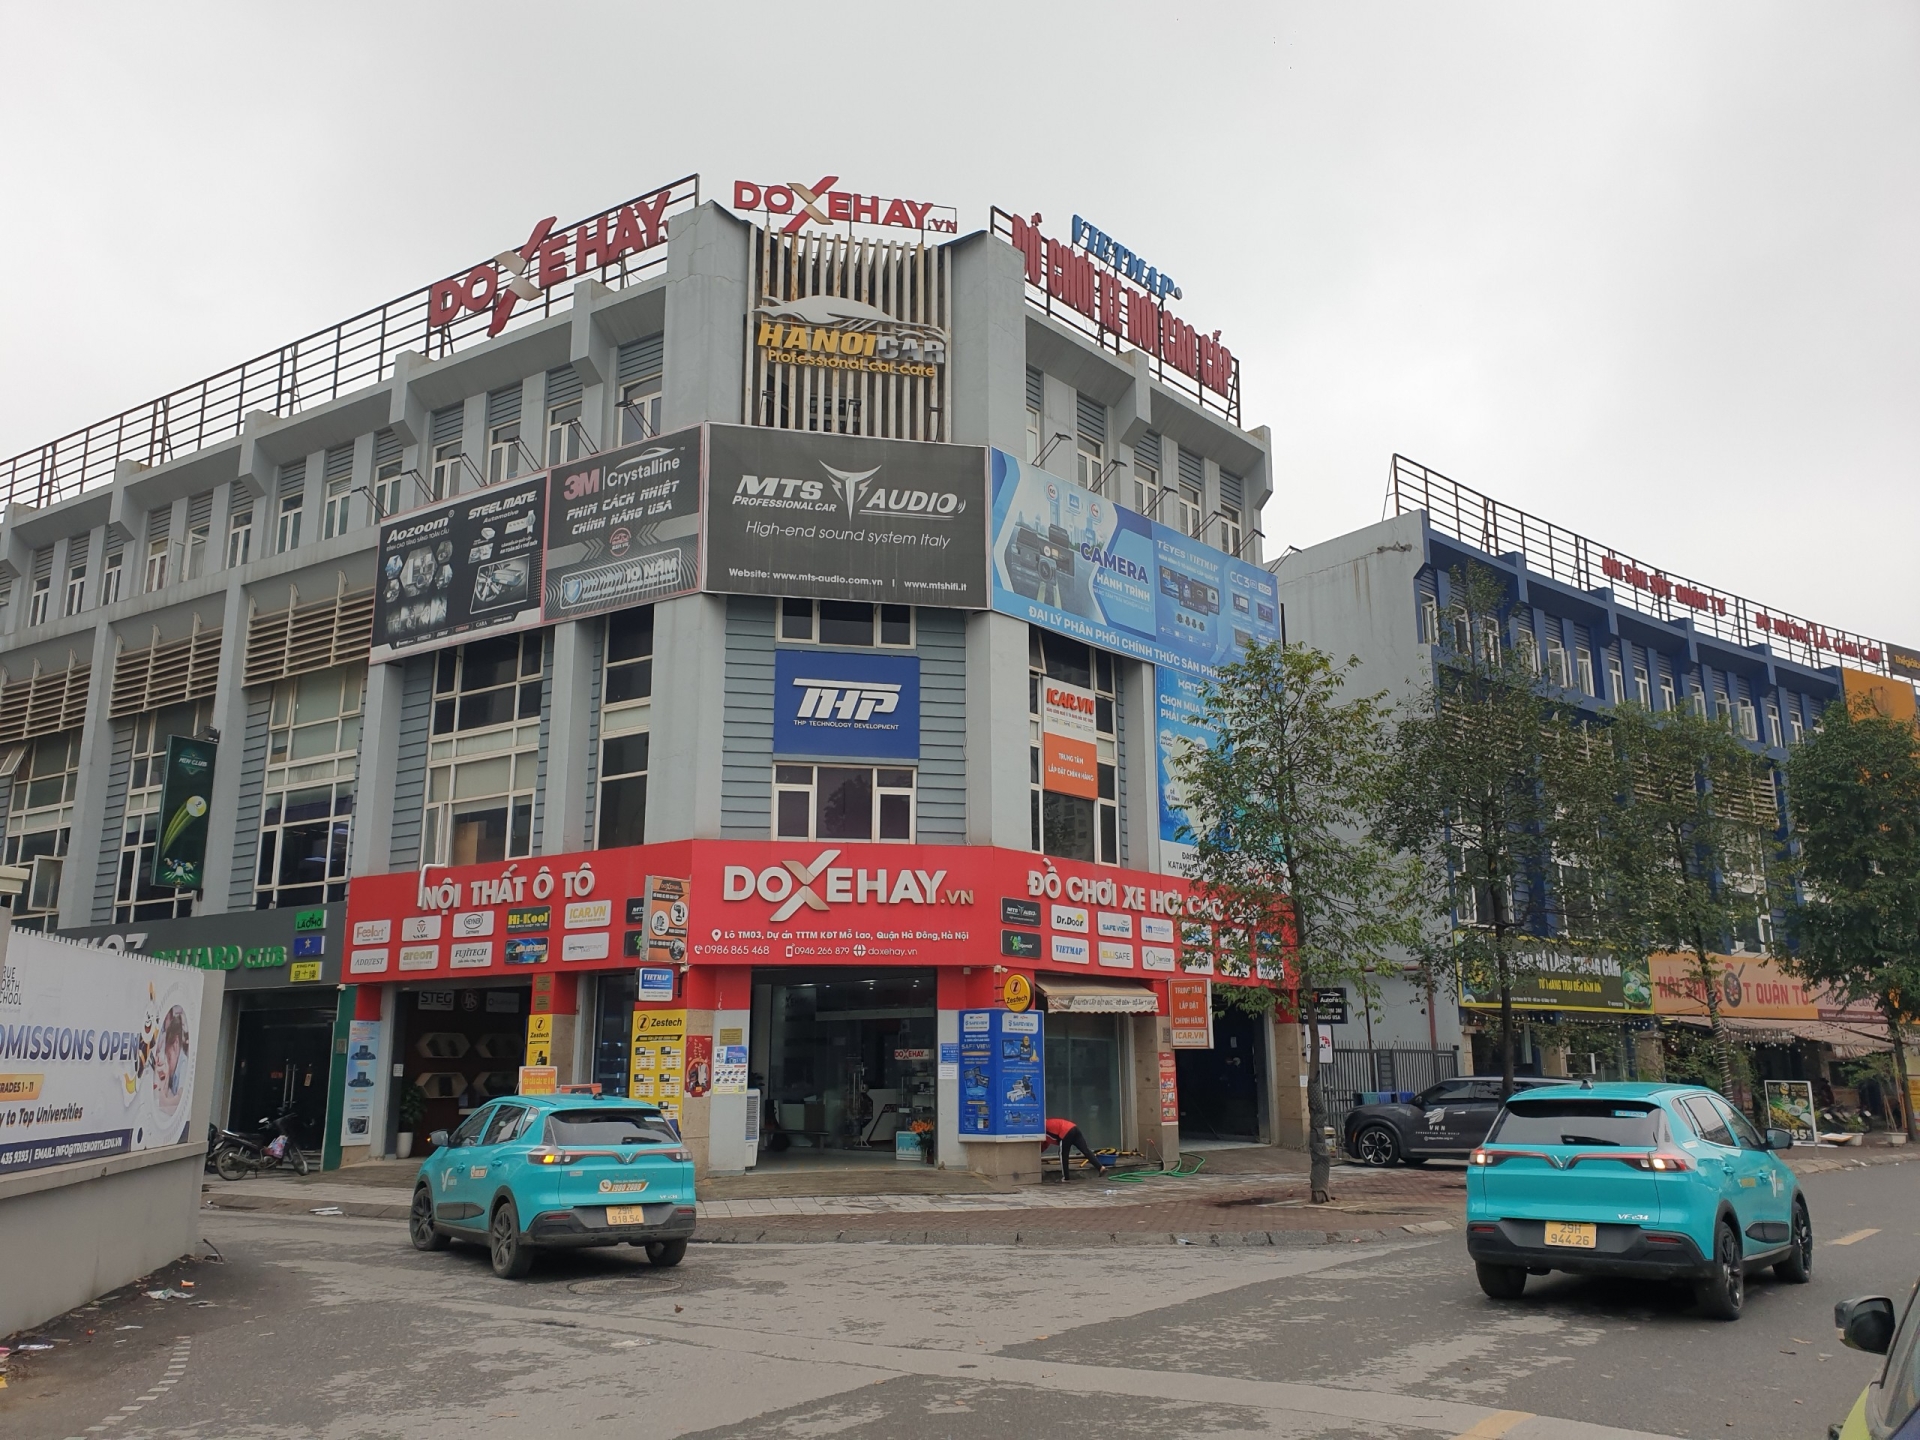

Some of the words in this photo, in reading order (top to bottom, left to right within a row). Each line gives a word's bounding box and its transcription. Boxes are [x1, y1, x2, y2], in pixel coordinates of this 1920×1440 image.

[1071, 214, 1175, 300] VIETMAP
[1050, 238, 1095, 319] CHƠI
[1100, 270, 1122, 335] XE
[1127, 287, 1159, 356] HƠI
[1162, 310, 1198, 377] CAO
[1201, 330, 1233, 396] CẤP
[767, 350, 864, 370] Professional
[868, 362, 895, 374] car
[899, 363, 936, 377] care
[564, 468, 600, 500] 3M
[607, 456, 680, 488] Crystalline
[736, 474, 824, 501] MTS
[866, 488, 958, 514] AUDIO
[647, 499, 672, 515] USA
[732, 495, 813, 512] PROFESSIONAL
[815, 502, 837, 513] CAR
[387, 516, 448, 543] Aozoom
[745, 521, 816, 539] High-end
[819, 528, 865, 543] sound
[867, 531, 917, 546] system
[921, 535, 951, 550] Italy
[1080, 542, 1149, 584] CAMERA
[729, 568, 771, 579] Website:
[772, 571, 883, 586] www.mts-audio.com.vn
[1229, 571, 1250, 588] CC3
[1096, 573, 1123, 592] HÀNH
[1125, 582, 1151, 602] TRÌNH
[1029, 606, 1048, 625] ĐẠI
[1050, 609, 1061, 625] LÝ
[1064, 614, 1093, 637] PHÂN
[1095, 624, 1120, 647] PHỐI
[1121, 635, 1153, 657] CHÍNH
[1154, 645, 1181, 667] THỨC
[1181, 655, 1199, 673] SẢN
[792, 678, 902, 721] THP
[1046, 687, 1095, 716] ICAR.VN
[1183, 700, 1201, 714] MUA
[809, 720, 852, 729] TECHNOLOGY
[423, 878, 462, 915] NỘI
[471, 864, 527, 906] THẤT
[533, 866, 554, 900] Ô
[563, 862, 596, 898] TÔ
[1027, 858, 1062, 900] ĐỒ
[1066, 876, 1117, 908] CHƠI
[1122, 884, 1146, 912] XE
[1150, 890, 1183, 916] HƠI
[508, 913, 548, 925] Hi-Kool
[570, 906, 607, 918] ICAR.VN
[1056, 915, 1083, 927] Dr.Door
[724, 930, 736, 940] Lô
[738, 931, 763, 941] TM03,
[767, 930, 780, 941] Dự
[782, 930, 793, 940] án
[796, 931, 818, 940] TTTM
[820, 931, 838, 940] KĐT
[839, 928, 853, 940] Mỗ
[855, 932, 874, 941] Lao,
[876, 931, 900, 942] Quận
[901, 930, 914, 940] Hà
[916, 930, 941, 942] Đông,
[941, 930, 953, 941] Hà
[954, 931, 969, 942] Nội
[1102, 924, 1116, 932] SAFE
[1116, 925, 1130, 933] VIEW
[244, 946, 287, 969] CLUB
[403, 950, 433, 960] areon
[704, 945, 729, 955] 0986
[730, 945, 749, 955] 865
[751, 945, 770, 955] 468
[794, 946, 815, 956] 0946
[835, 946, 850, 956] 879
[867, 946, 918, 957] doxehay.vn
[1055, 944, 1084, 956] VIETMAP
[651, 1018, 682, 1027] Zestech
[1175, 1032, 1204, 1040] ICAR.VN
[99, 1030, 139, 1061] OPEN
[6, 1109, 17, 1125] to
[18, 1107, 34, 1128] Top
[36, 1102, 84, 1122] Universities
[611, 1216, 640, 1224] 918.54
[1560, 1223, 1582, 1234] 29H
[1550, 1233, 1590, 1246] 944.26
